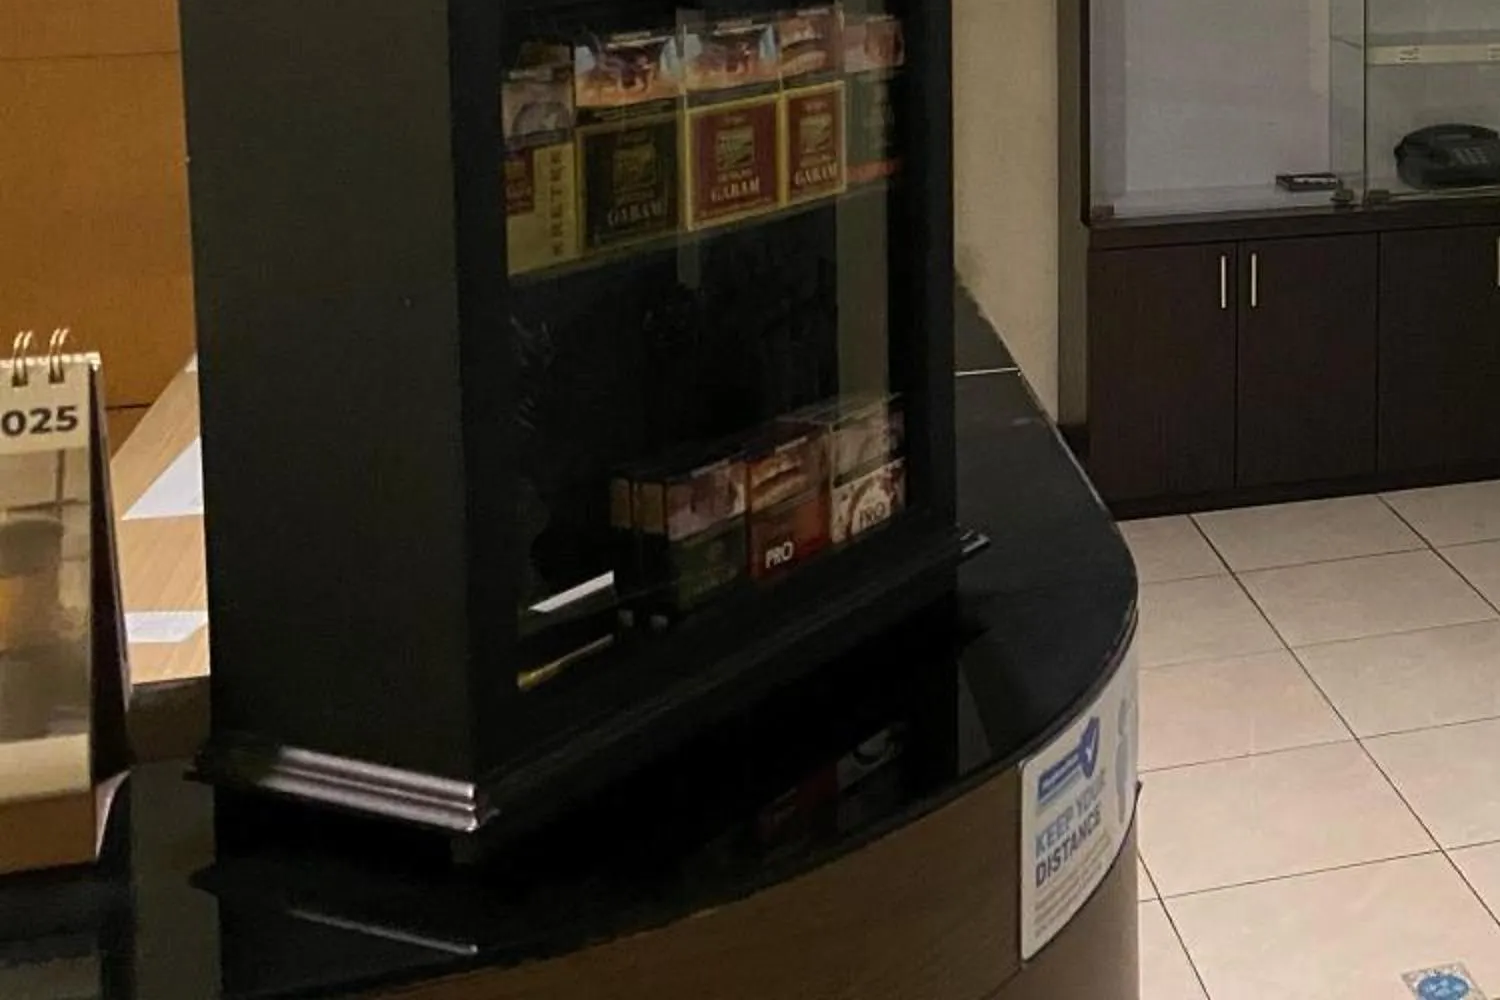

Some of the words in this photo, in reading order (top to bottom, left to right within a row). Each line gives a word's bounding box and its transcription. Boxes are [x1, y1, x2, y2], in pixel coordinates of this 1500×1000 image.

[765, 540, 795, 569] PRO
[1035, 804, 1074, 860] KEEP
[1035, 803, 1102, 889] DISTANCE
